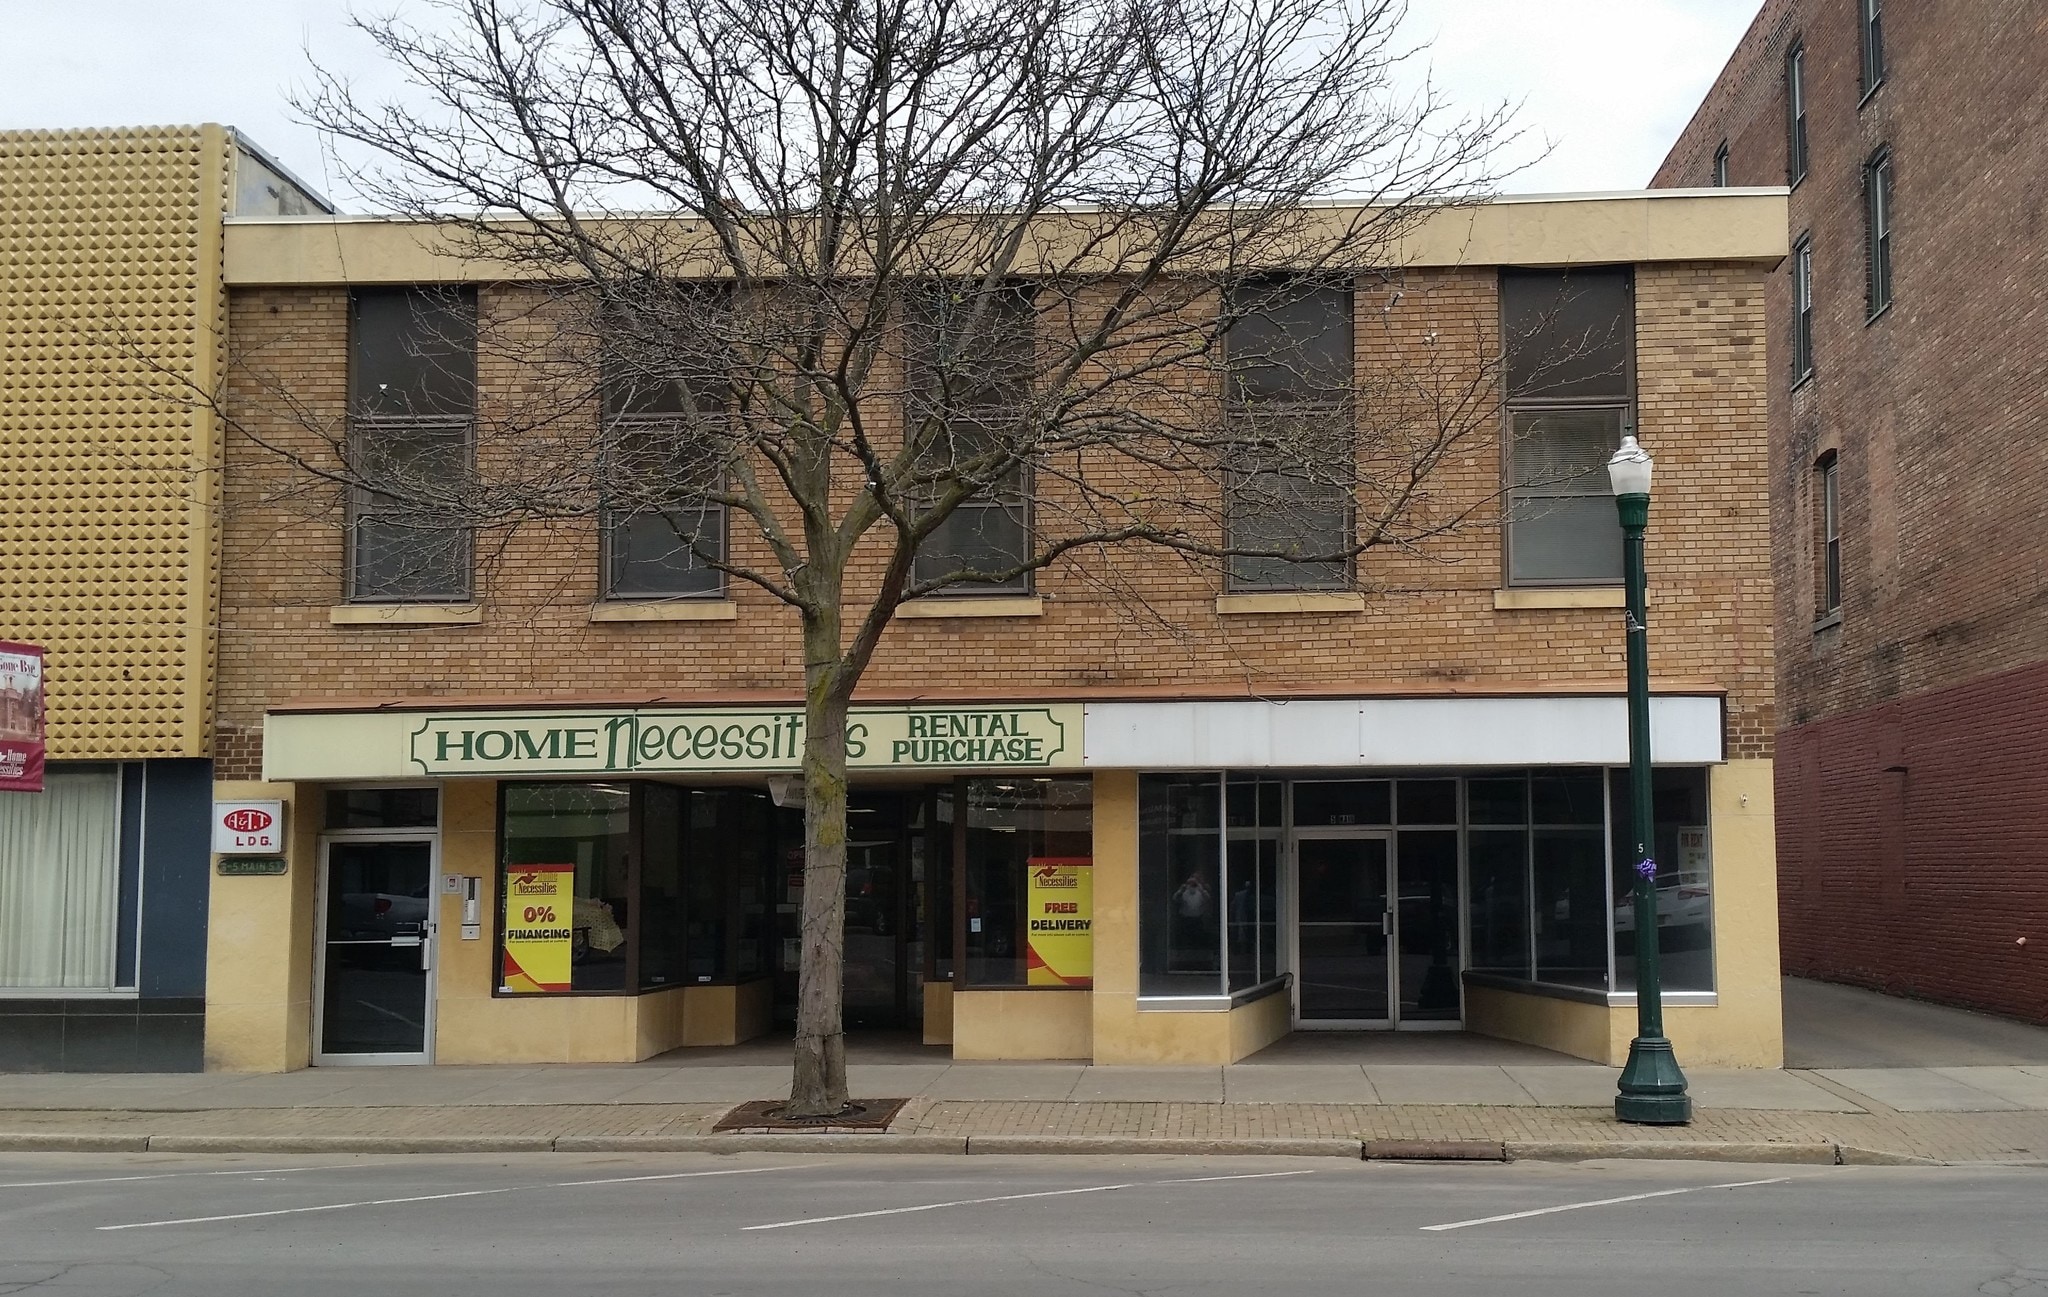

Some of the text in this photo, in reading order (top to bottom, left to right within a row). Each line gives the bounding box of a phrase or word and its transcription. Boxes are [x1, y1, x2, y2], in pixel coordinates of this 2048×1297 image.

[908, 714, 1029, 737] RENTAL
[434, 716, 869, 769] HOME necessits
[7, 748, 27, 761] Home
[892, 738, 1043, 763] PURCHASE
[1638, 843, 1644, 853] 5
[241, 862, 266, 872] MAIN
[1039, 875, 1078, 887] Necessities
[518, 882, 557, 894] Necessities
[1044, 902, 1078, 914] FREE
[524, 906, 556, 923] 0%
[1031, 919, 1092, 931] DELIVERY
[508, 928, 571, 940] FINANCING
